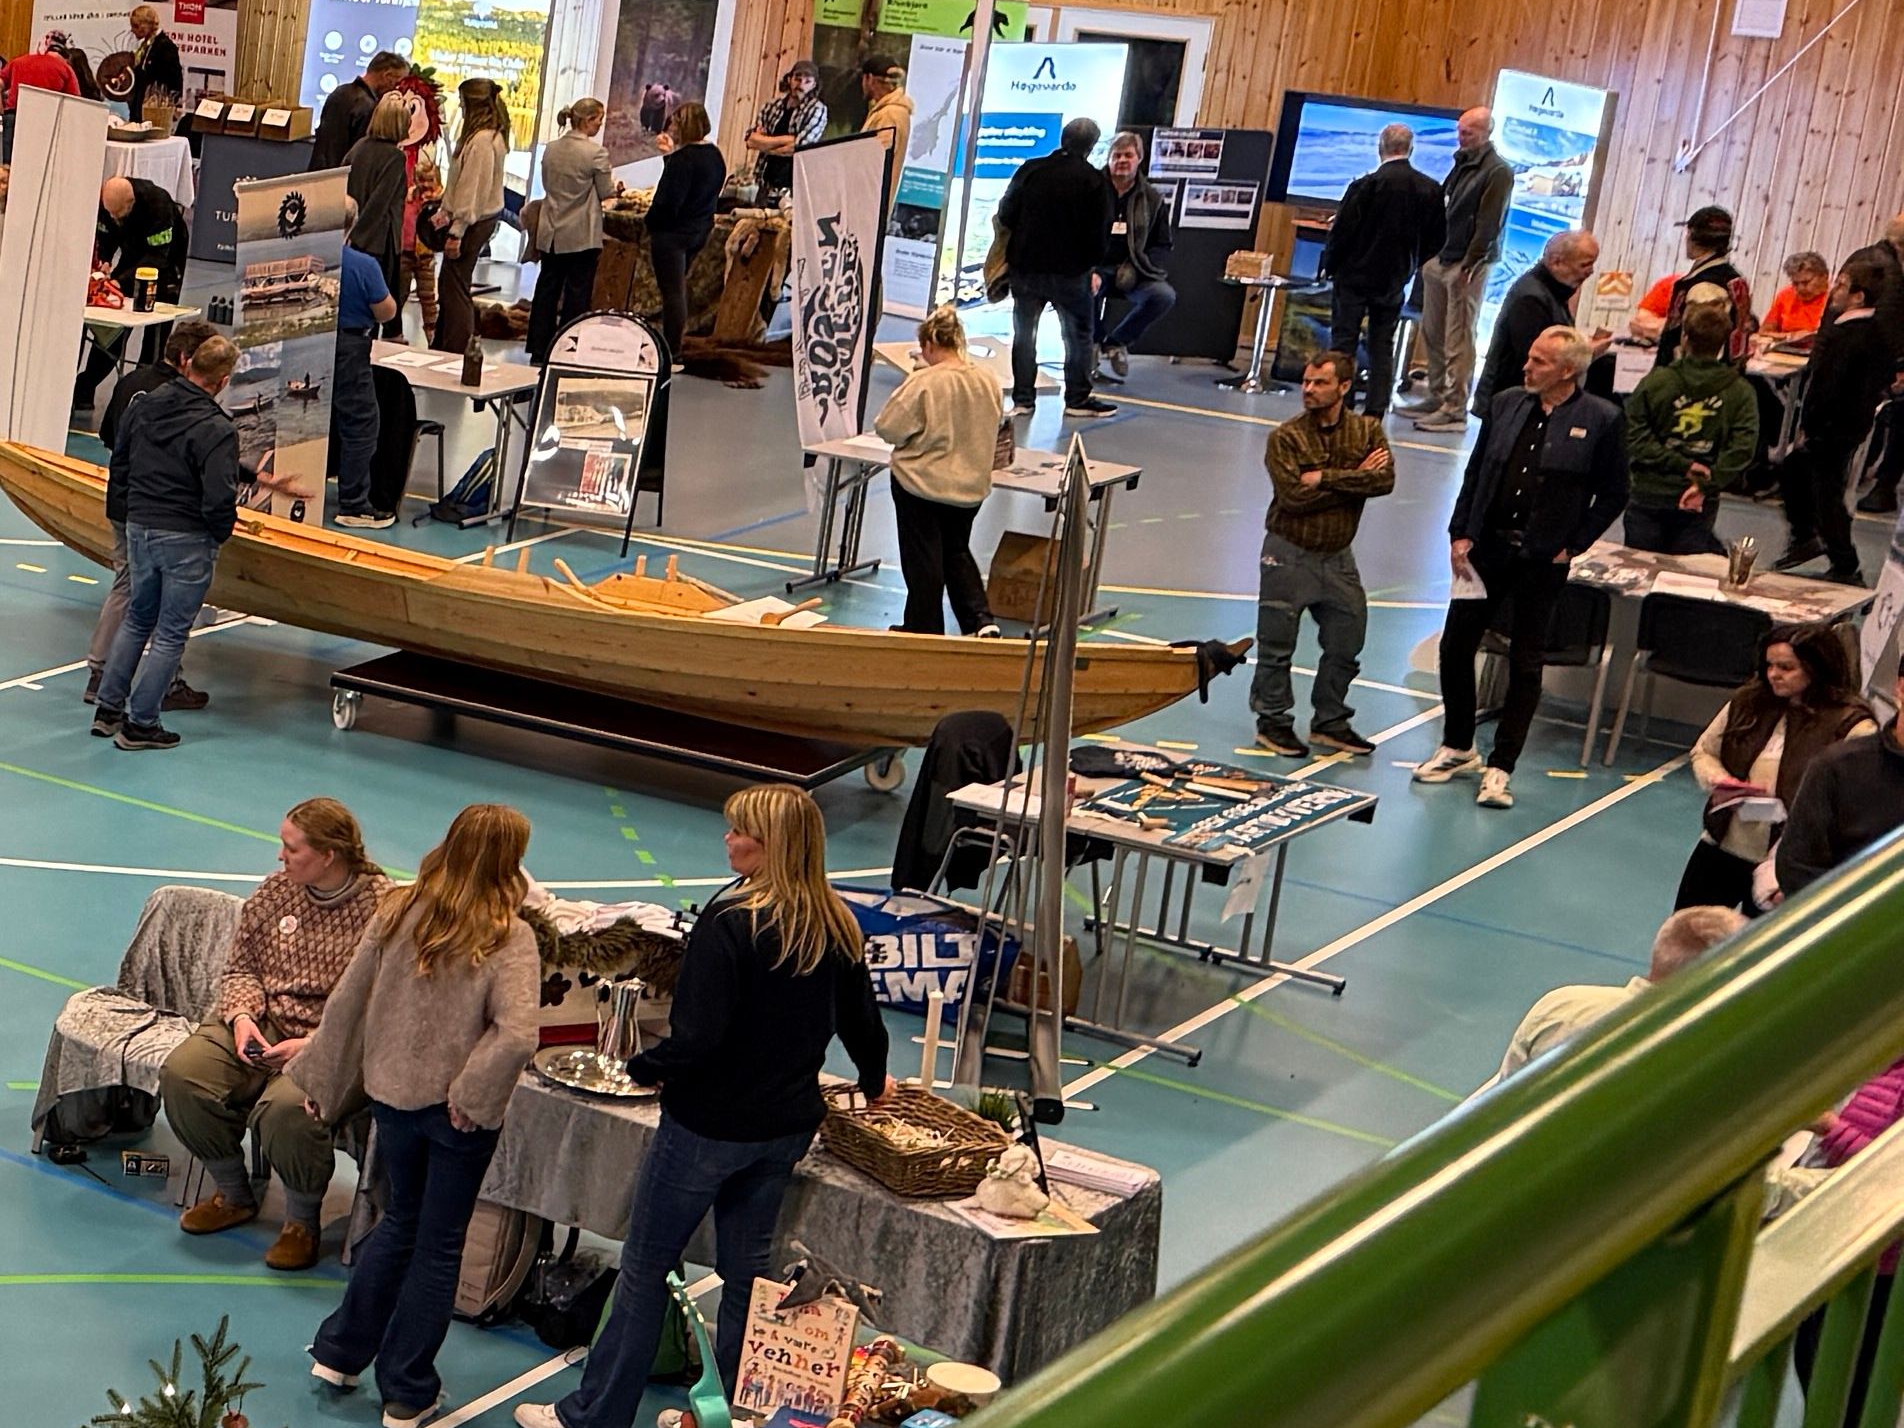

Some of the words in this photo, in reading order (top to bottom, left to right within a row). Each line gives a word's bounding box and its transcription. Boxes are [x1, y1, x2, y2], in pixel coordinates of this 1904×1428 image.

[179, 2, 202, 12] THON
[187, 33, 218, 44] HOTEL
[870, 970, 967, 1003] EMA
[805, 1326, 829, 1341] om
